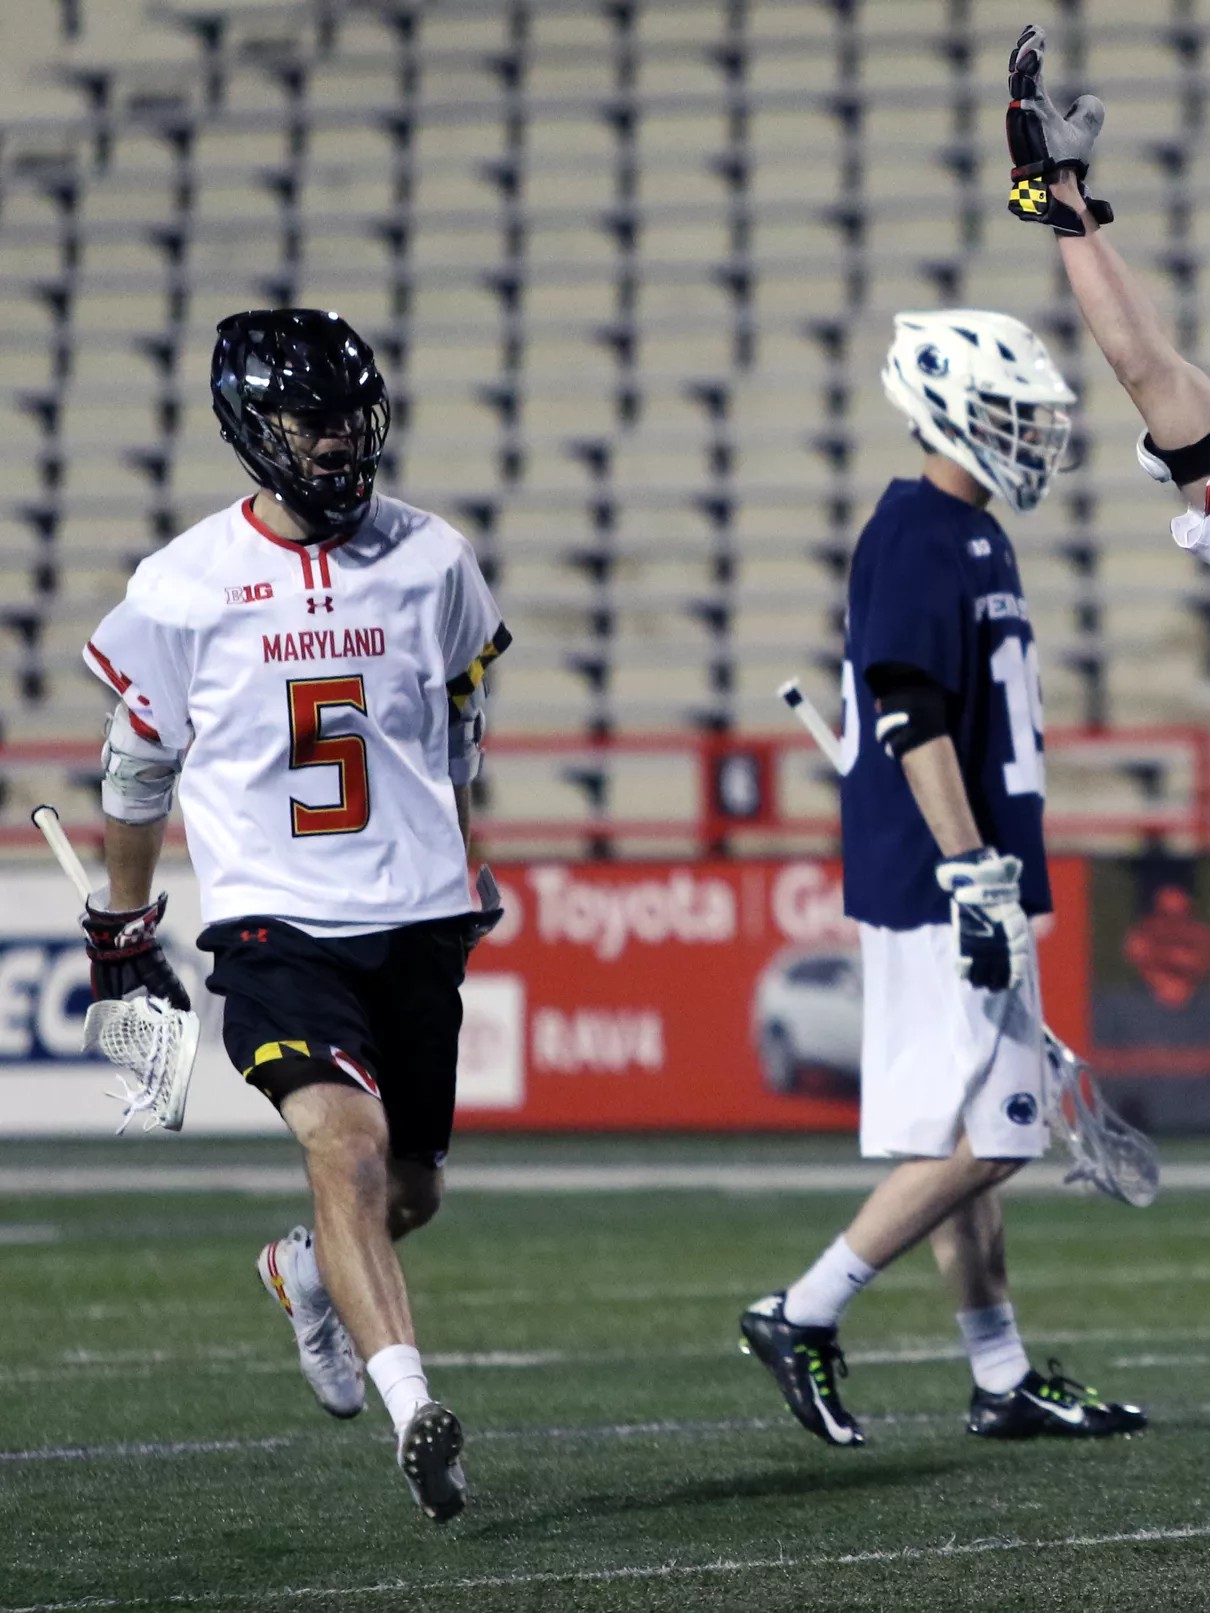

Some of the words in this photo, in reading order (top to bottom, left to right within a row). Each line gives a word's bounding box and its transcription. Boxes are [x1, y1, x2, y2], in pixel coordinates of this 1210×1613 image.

[262, 627, 385, 663] MARYLAND
[286, 674, 371, 838] 5
[528, 864, 737, 961] Toyota
